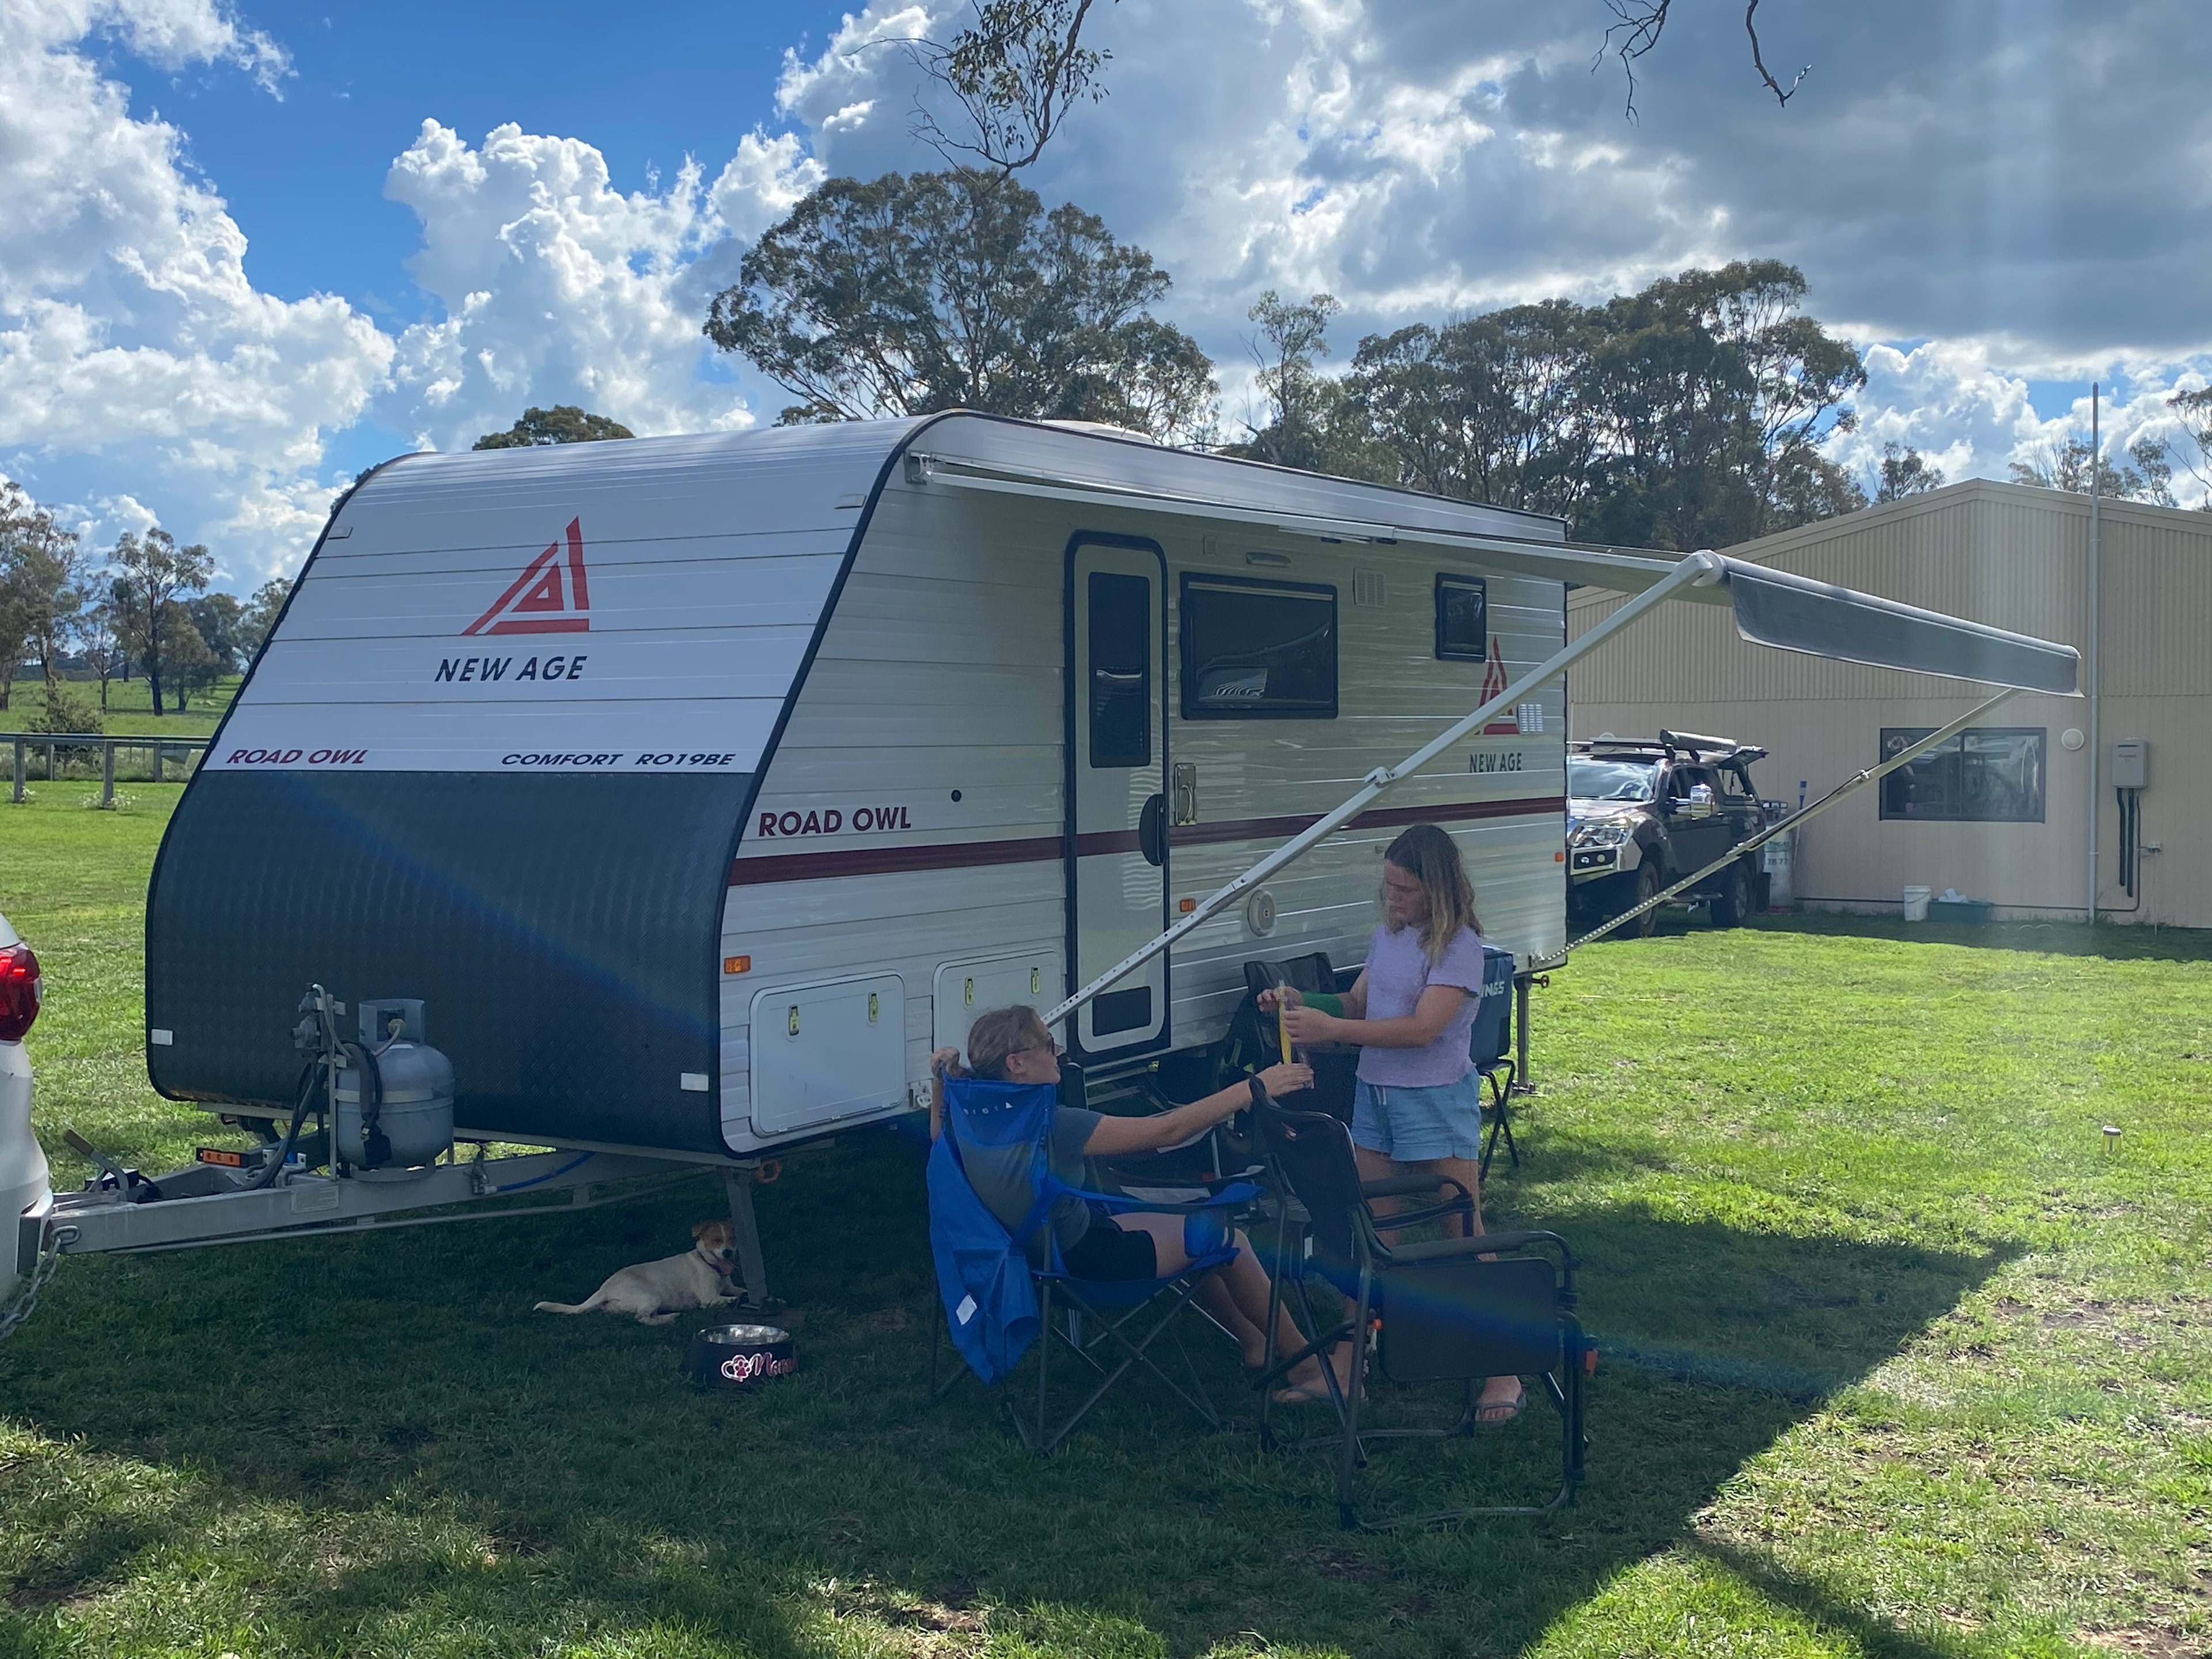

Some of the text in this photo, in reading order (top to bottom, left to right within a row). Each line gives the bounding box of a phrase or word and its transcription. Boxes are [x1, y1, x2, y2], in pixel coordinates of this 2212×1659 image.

[434, 655, 588, 682] NEW AGE
[226, 749, 369, 764] ROAD OWL
[501, 753, 623, 766] COMFORT
[1469, 752, 1522, 773] NEW AGE
[758, 806, 911, 837] ROAD OWL
[1480, 980, 1505, 998] INGS
